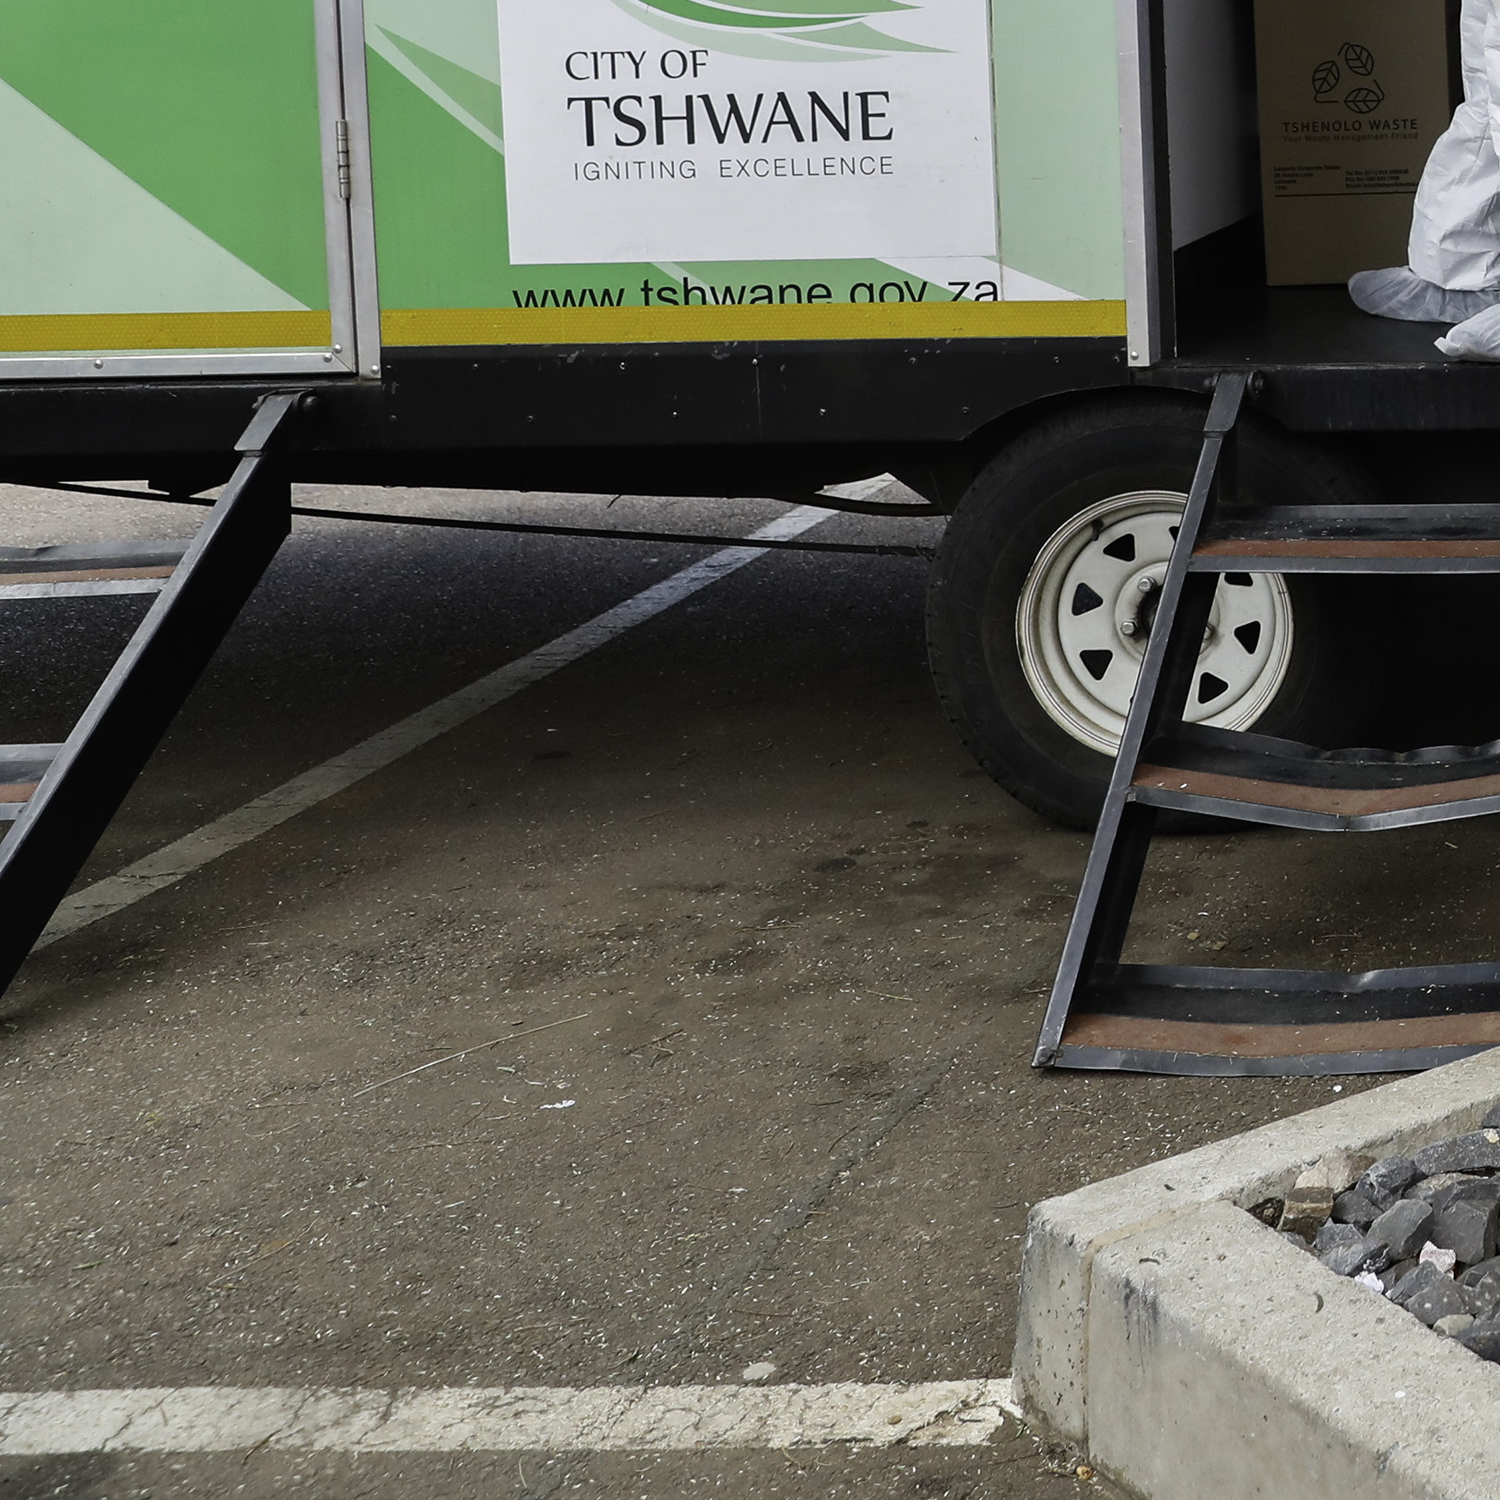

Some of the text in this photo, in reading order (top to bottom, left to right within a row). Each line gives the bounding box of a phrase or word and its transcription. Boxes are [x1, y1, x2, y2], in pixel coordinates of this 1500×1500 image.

[564, 49, 709, 81] CITY OF
[566, 90, 894, 148] TSHWANE
[1283, 118, 1418, 133] TSHENOLO WASTE
[574, 155, 894, 181] IGNITING EXCELLENCE
[512, 277, 999, 309] wwwtshwanegovza
